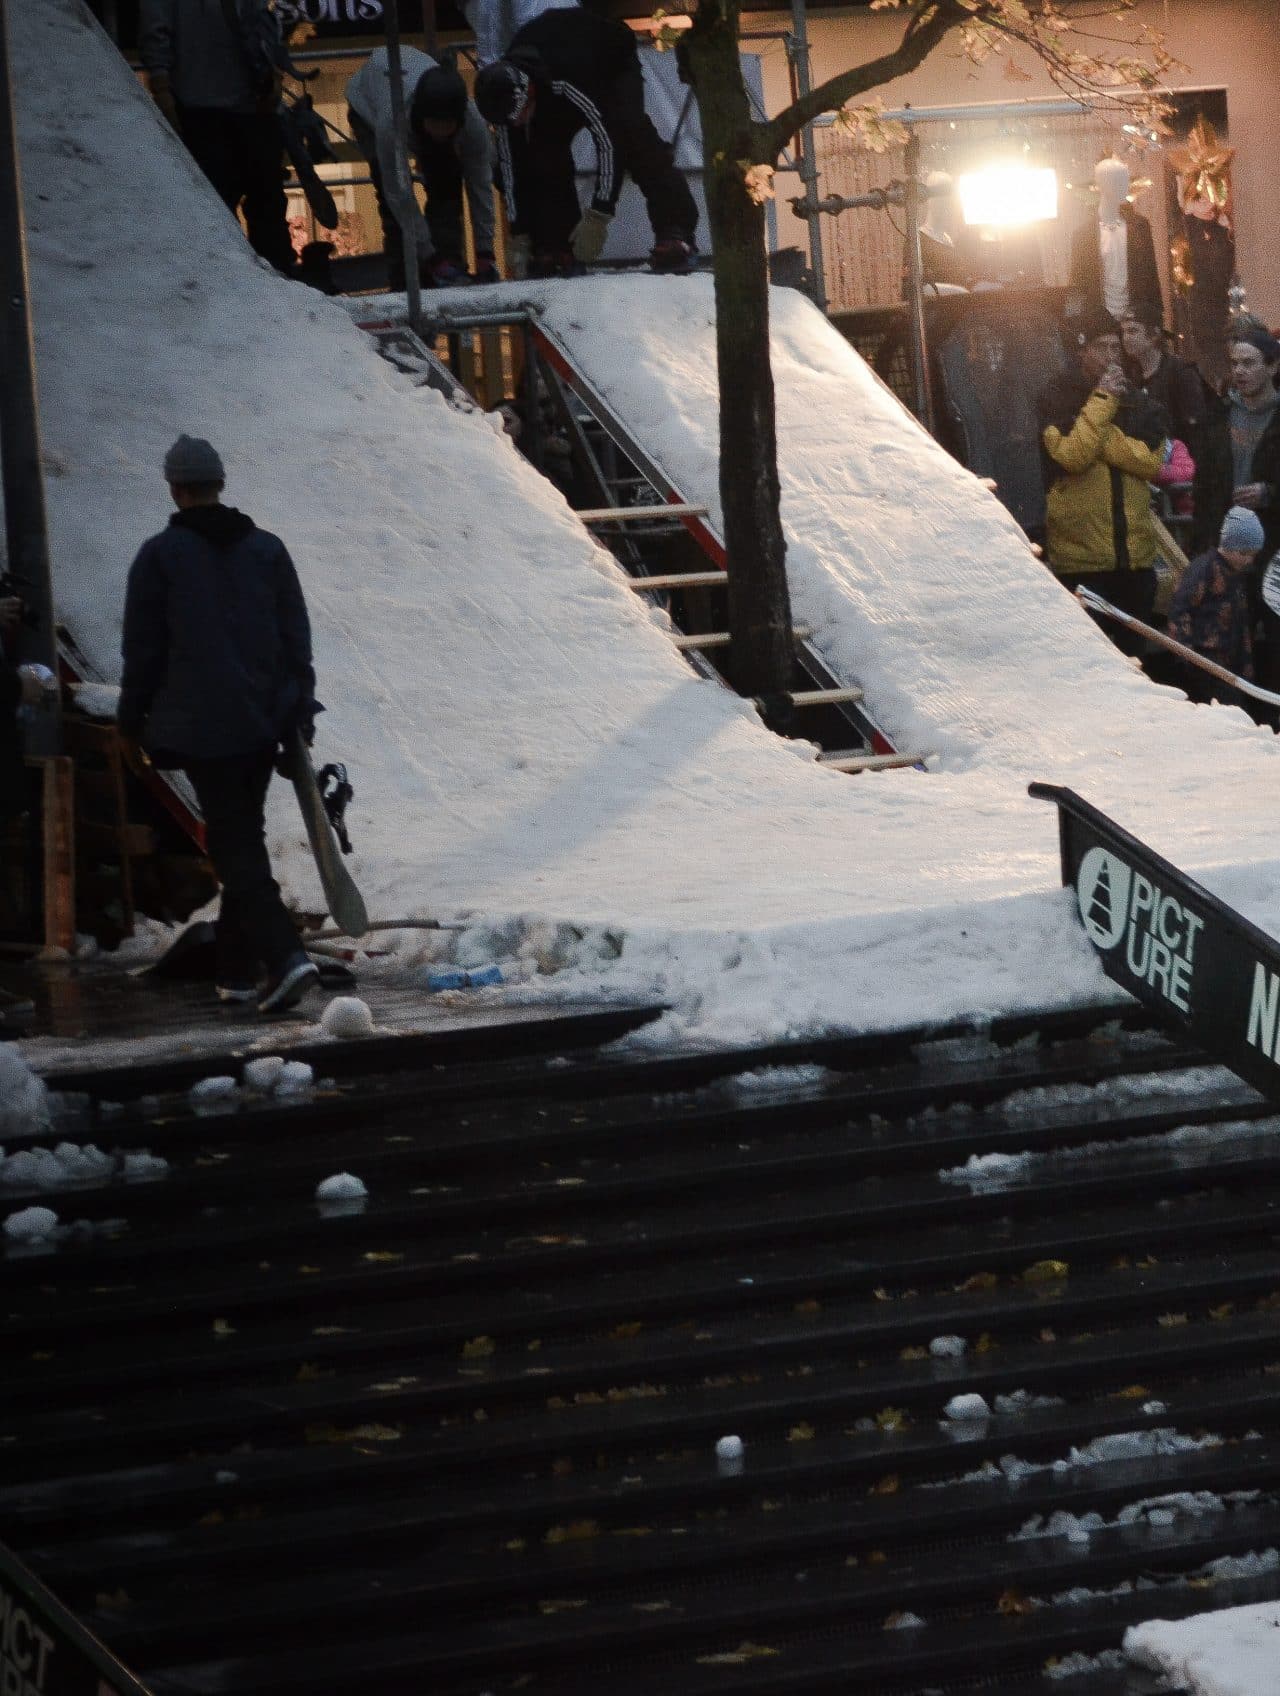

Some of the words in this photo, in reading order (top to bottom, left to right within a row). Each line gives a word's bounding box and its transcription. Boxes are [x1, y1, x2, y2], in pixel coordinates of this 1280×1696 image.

[1130, 871, 1204, 949] PICT
[1127, 922, 1194, 1013] URE
[0, 1590, 55, 1690] ICT
